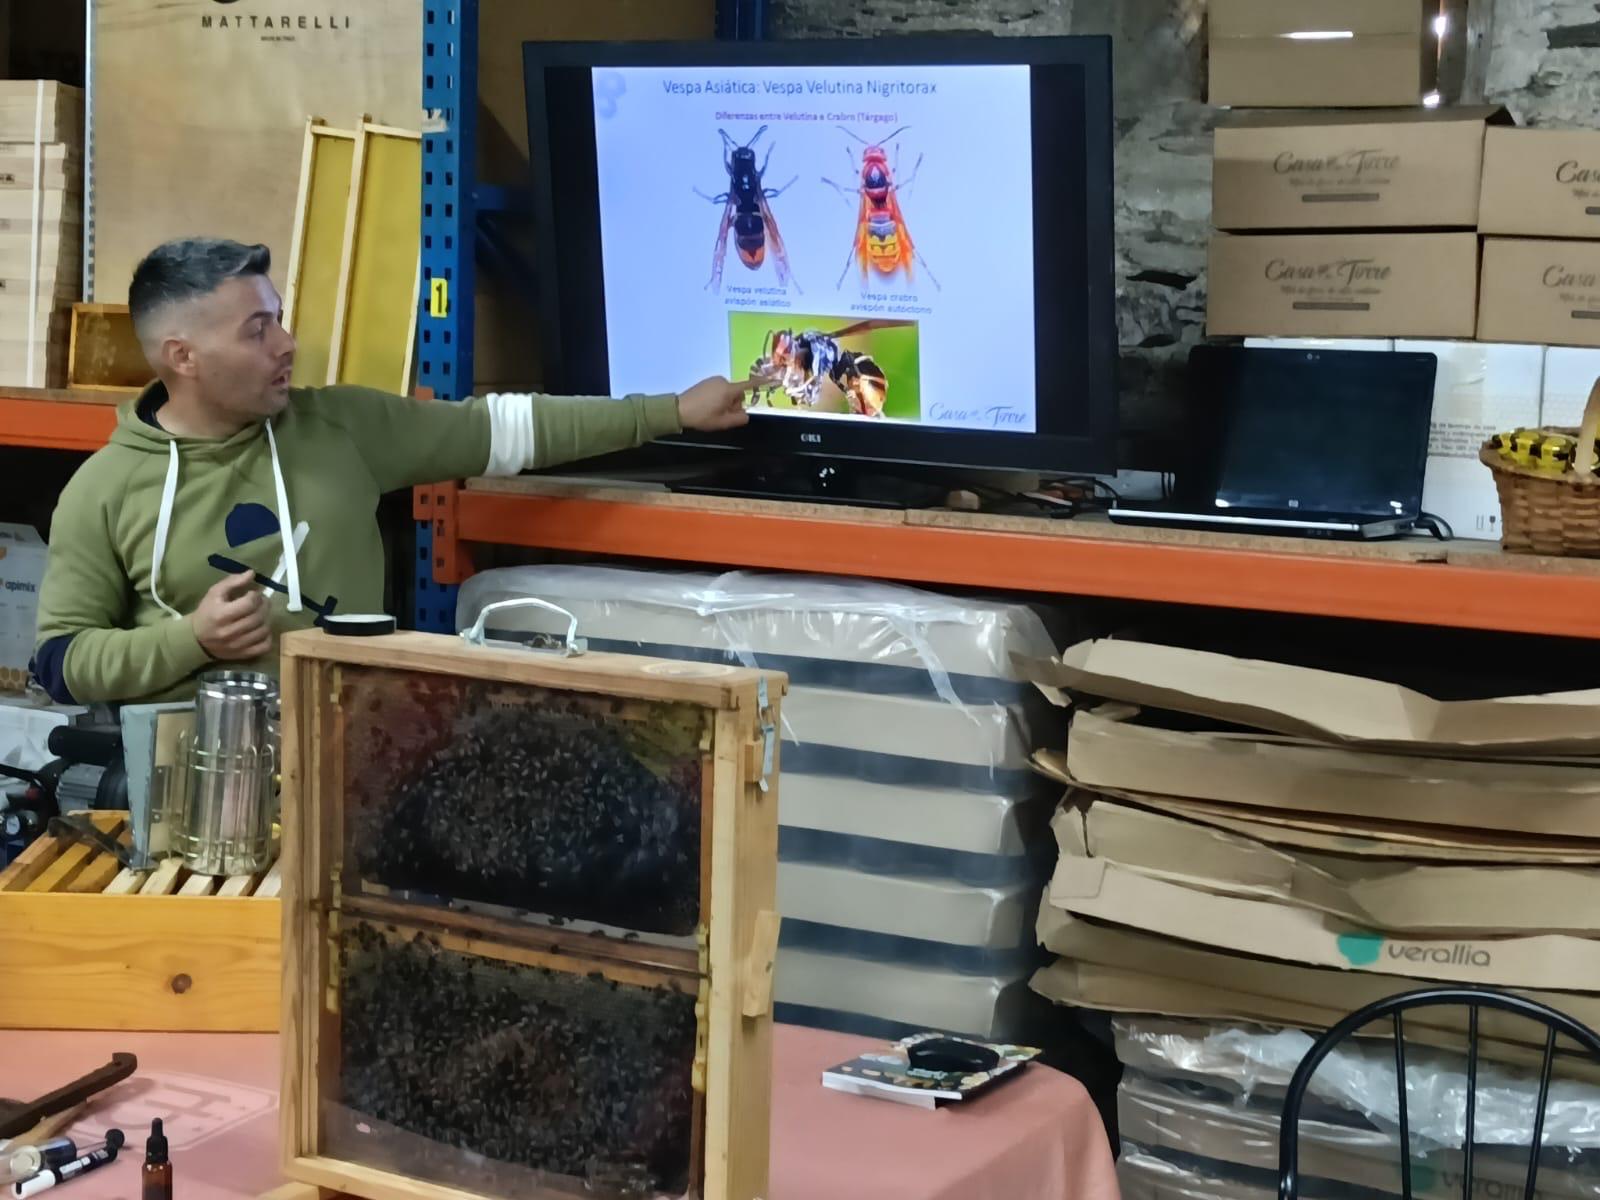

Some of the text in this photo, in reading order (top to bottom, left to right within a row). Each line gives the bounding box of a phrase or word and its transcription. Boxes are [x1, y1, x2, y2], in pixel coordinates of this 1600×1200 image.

[201, 15, 350, 29] MATTARELLI
[663, 79, 937, 98] Vespa Asiática: Vespa Velutina Nigritorax
[760, 112, 782, 121] entre
[783, 112, 818, 121] Velutina
[435, 282, 443, 314] 1
[5, 580, 36, 593] apimix
[1388, 943, 1491, 967] verallia
